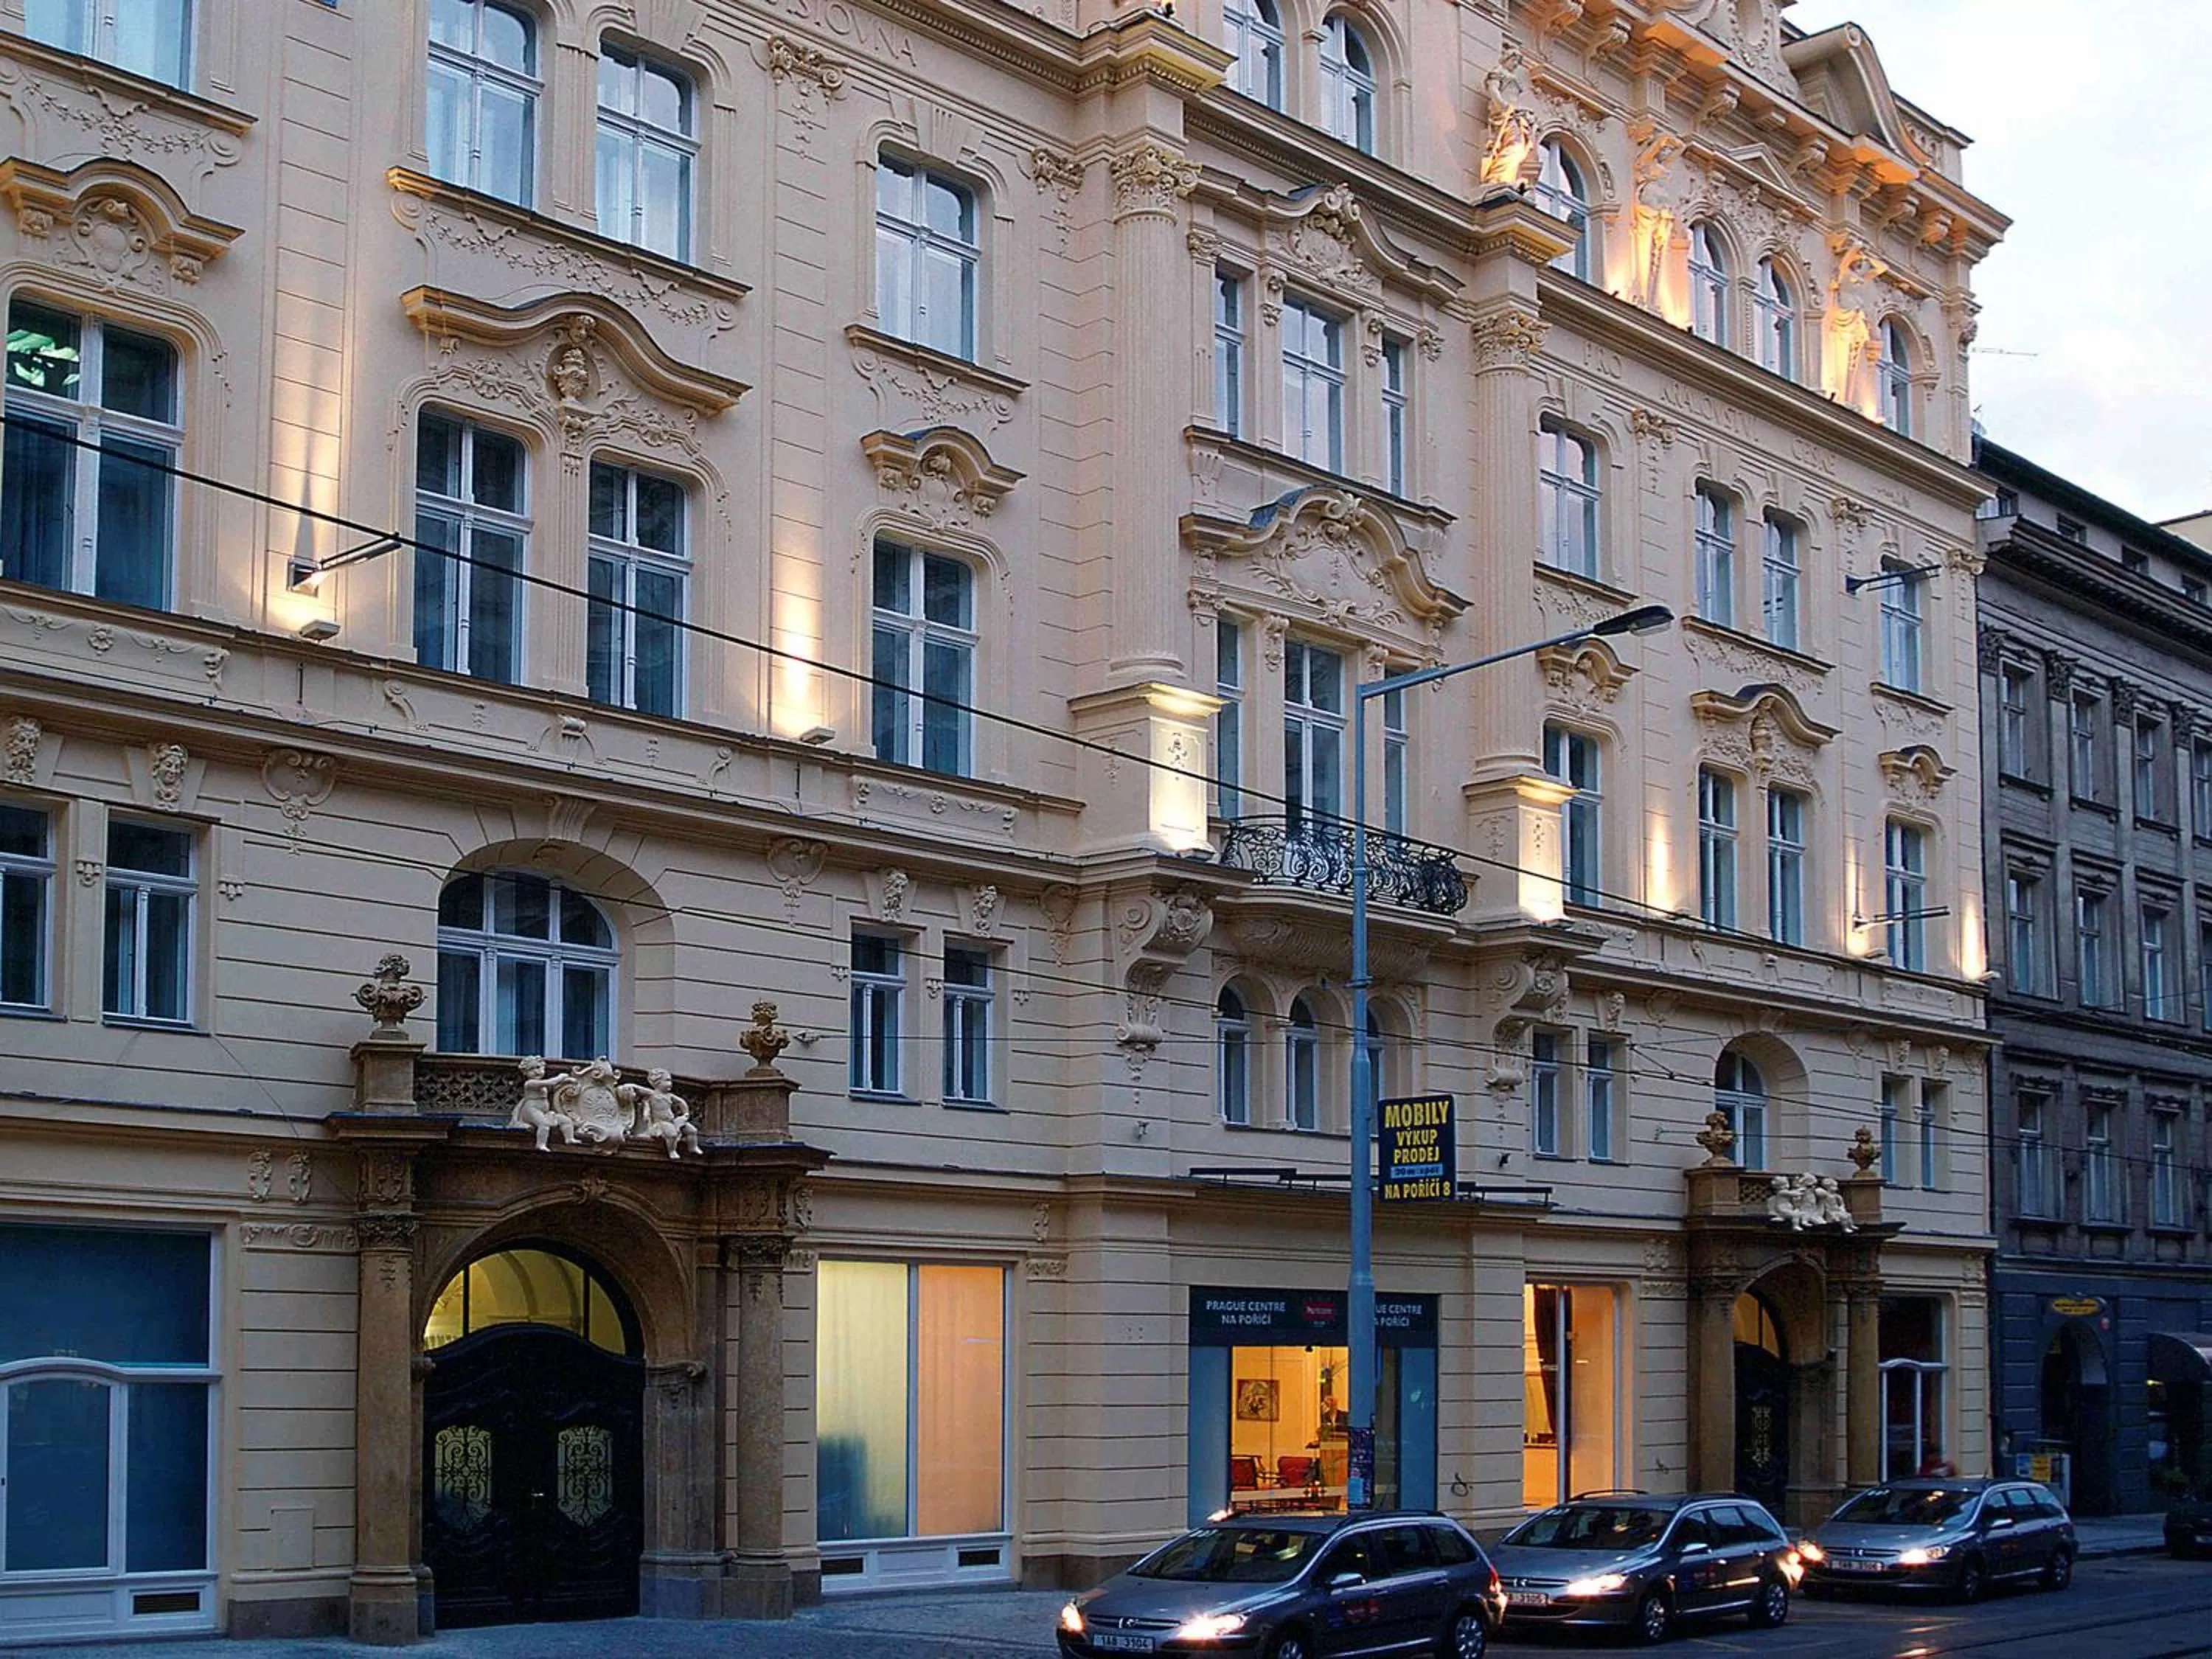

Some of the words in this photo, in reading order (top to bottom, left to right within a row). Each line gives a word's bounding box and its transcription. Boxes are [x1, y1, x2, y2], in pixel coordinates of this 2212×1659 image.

[1385, 1101, 1449, 1128] MOBILY
[1397, 1127, 1438, 1146] VÝKUP
[1394, 1146, 1440, 1164] PRODEJ
[1384, 1184, 1400, 1199] NA
[1443, 1181, 1451, 1196] 8
[1206, 1300, 1246, 1311] PRAGUE
[1248, 1301, 1286, 1312] CENTRE
[1388, 1304, 1422, 1315] CENTRE
[1221, 1315, 1237, 1325] NA
